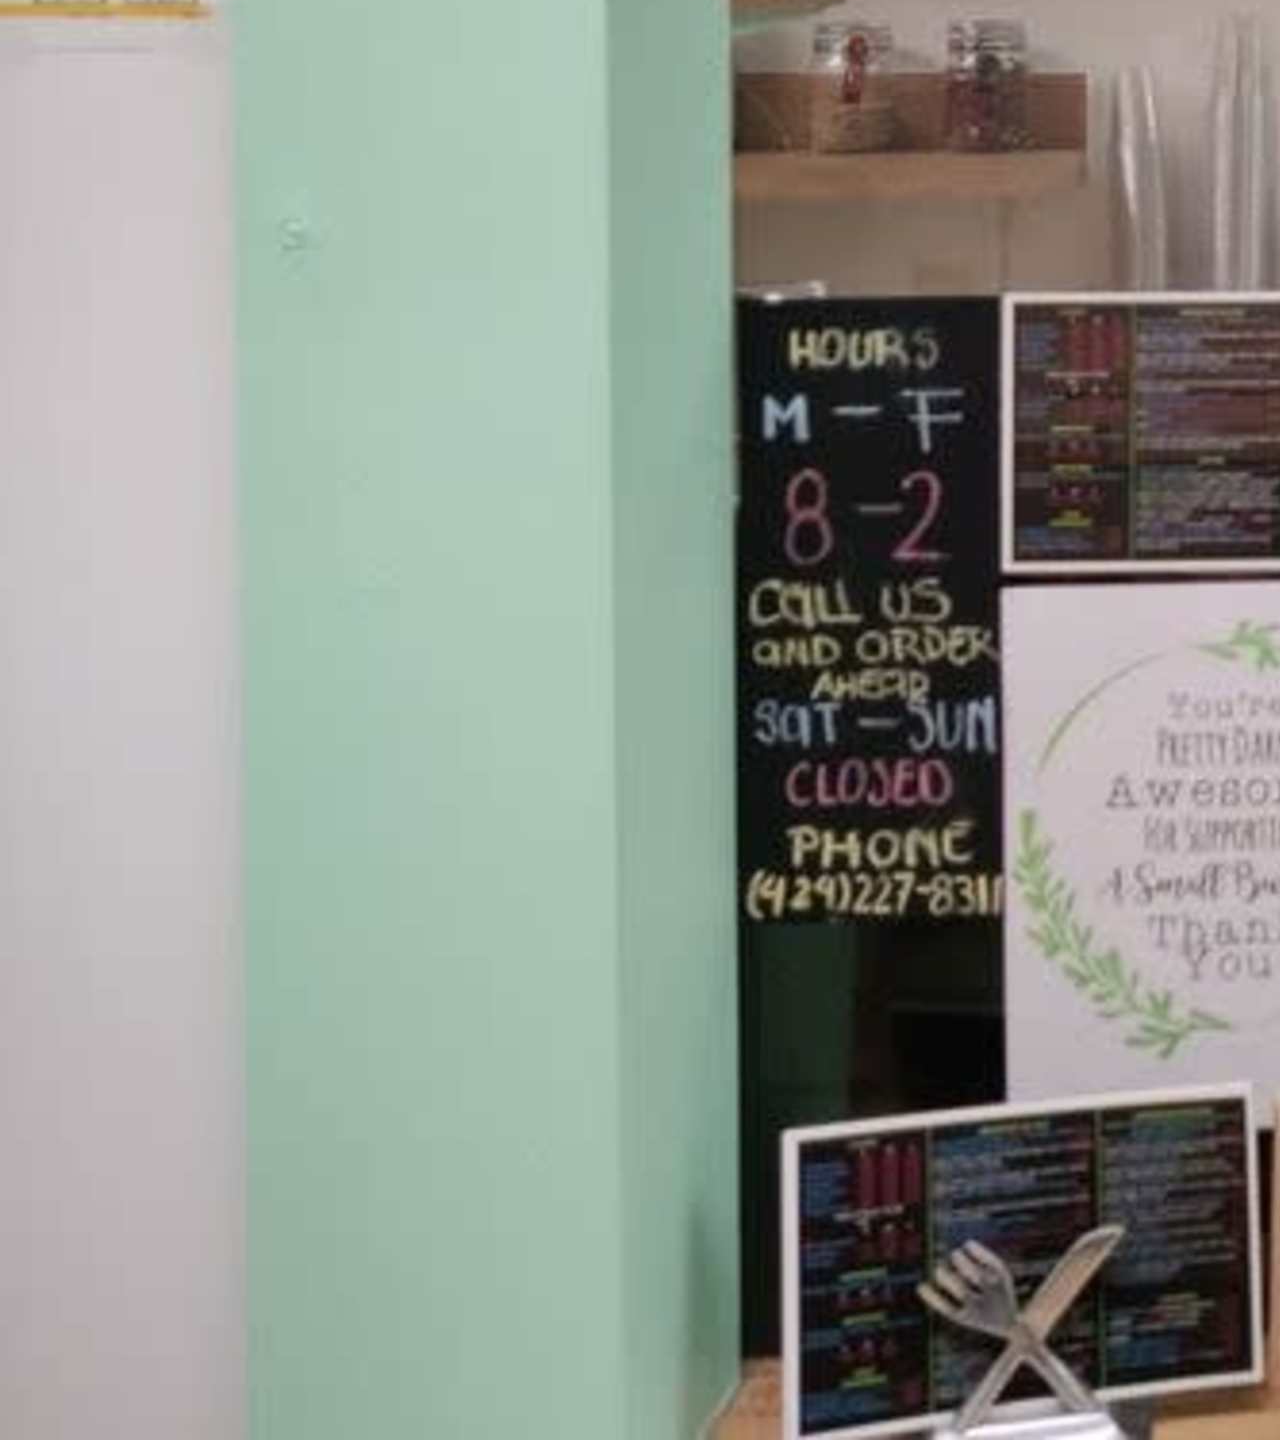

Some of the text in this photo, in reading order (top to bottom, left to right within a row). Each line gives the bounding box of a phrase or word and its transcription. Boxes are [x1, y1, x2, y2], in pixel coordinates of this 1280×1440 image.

[788, 326, 941, 371] HOURS
[762, 393, 812, 444] M
[899, 388, 965, 454] F
[783, 467, 835, 567] 8
[890, 470, 952, 561] 2
[879, 577, 954, 623] US
[855, 624, 1001, 666] ORDER
[905, 695, 998, 753] SUN
[1155, 725, 1228, 767] PRETTY
[785, 759, 955, 808] CLOSED
[786, 818, 976, 869] PHONE
[1131, 860, 1226, 904] Small
[1186, 951, 1273, 983] You
